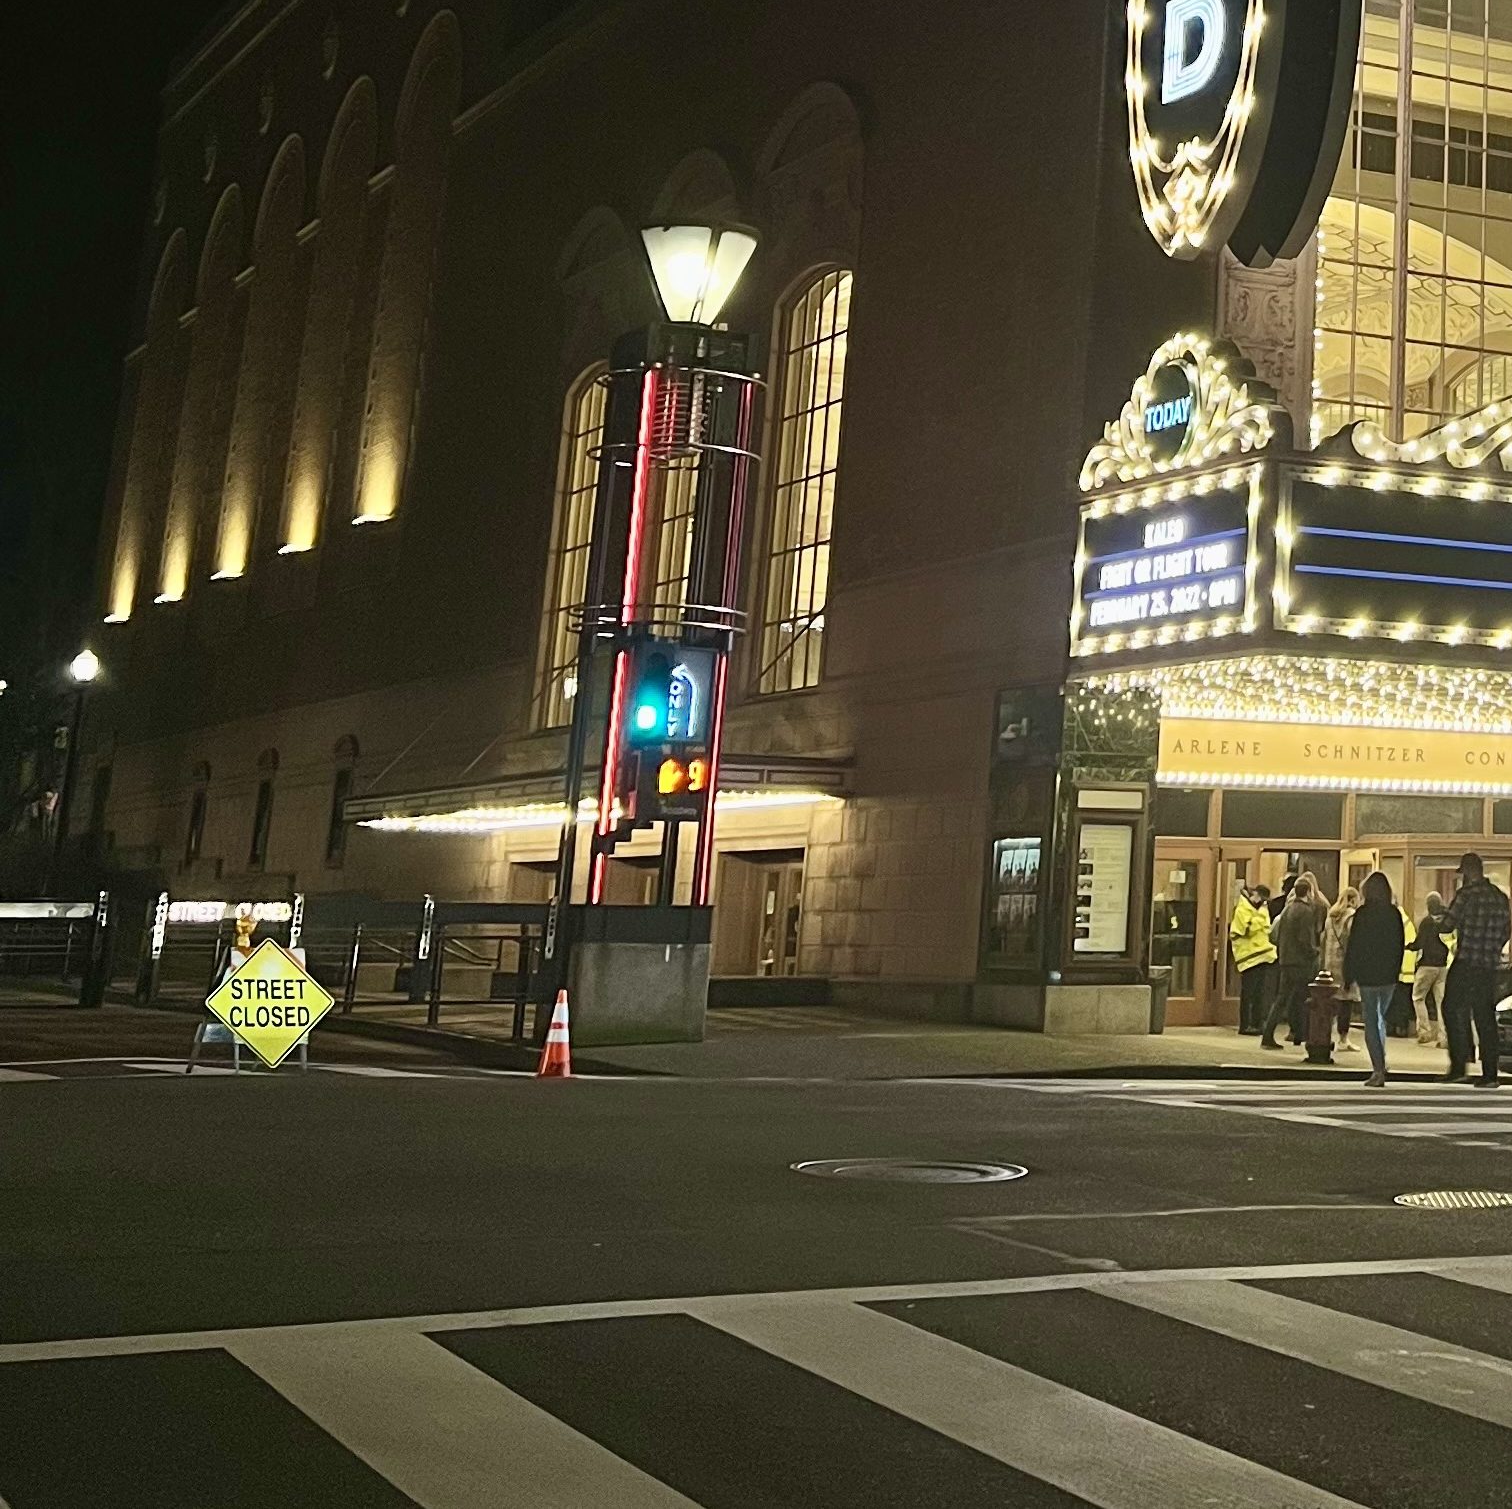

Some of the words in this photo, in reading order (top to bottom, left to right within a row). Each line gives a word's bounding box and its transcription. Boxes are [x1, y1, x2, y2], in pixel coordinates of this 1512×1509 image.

[1145, 394, 1193, 433] TODAY
[667, 681, 683, 737] ONLY
[1172, 738, 1262, 756] ARLENE
[1303, 743, 1426, 763] SCHNITZER
[231, 979, 307, 999] STREET
[230, 1006, 309, 1027] CLOSED
